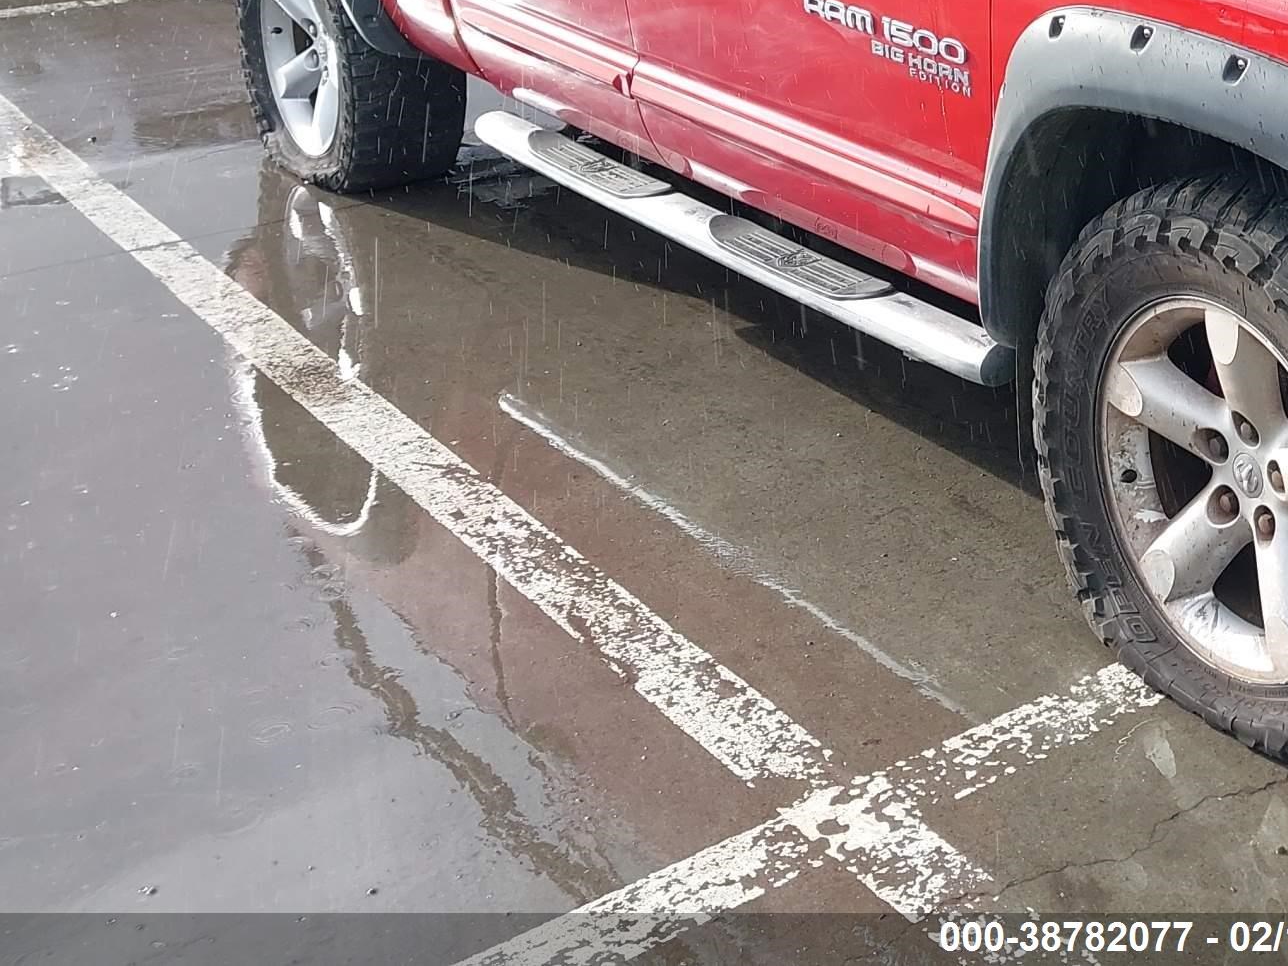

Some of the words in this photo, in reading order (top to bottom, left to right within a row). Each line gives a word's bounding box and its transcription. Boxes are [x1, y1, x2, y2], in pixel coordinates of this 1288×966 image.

[871, 40, 904, 64] BIG
[909, 53, 969, 86] HORN
[882, 16, 967, 65] 1500
[909, 68, 971, 98] EDITION
